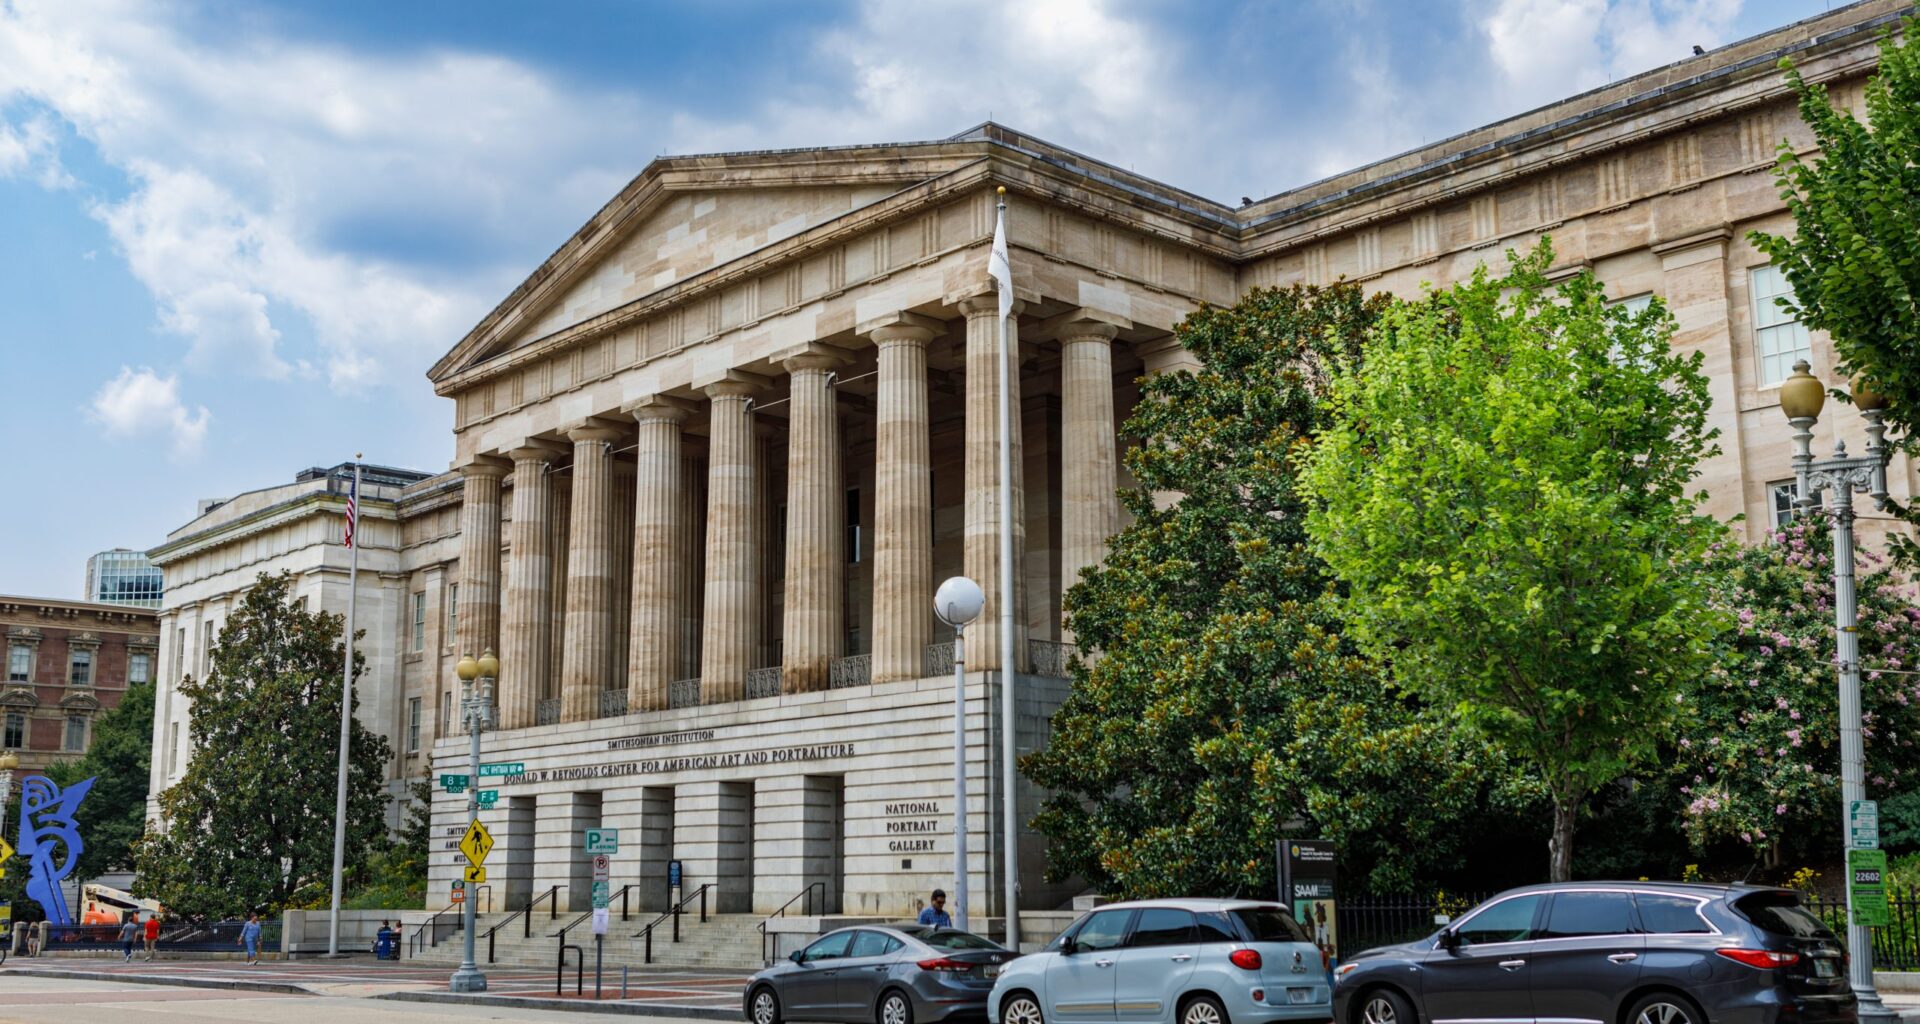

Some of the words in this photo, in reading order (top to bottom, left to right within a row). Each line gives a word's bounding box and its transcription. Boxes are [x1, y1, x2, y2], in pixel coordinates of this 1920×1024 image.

[607, 736, 660, 749] SMITHSONIAN
[662, 730, 715, 744] INSTITUTION
[491, 765, 508, 775] WHITMAN
[509, 765, 517, 774] WAY
[504, 771, 538, 785] DONALD
[540, 771, 549, 781] W.
[552, 766, 599, 781] REYNOLDS
[601, 763, 638, 777] CENTER
[642, 761, 660, 774] FOR
[663, 756, 717, 772] AMERICAN
[721, 753, 741, 767] ART
[744, 751, 768, 764] AND
[772, 744, 855, 762] PORTRAITURE
[447, 776, 454, 785] 8
[481, 792, 487, 801] F
[885, 802, 939, 814] NATIONAL
[886, 820, 938, 832] PORTRAIT
[889, 840, 935, 851] GALLERY
[1856, 872, 1880, 882] 22602
[1295, 884, 1318, 897] SAAM
